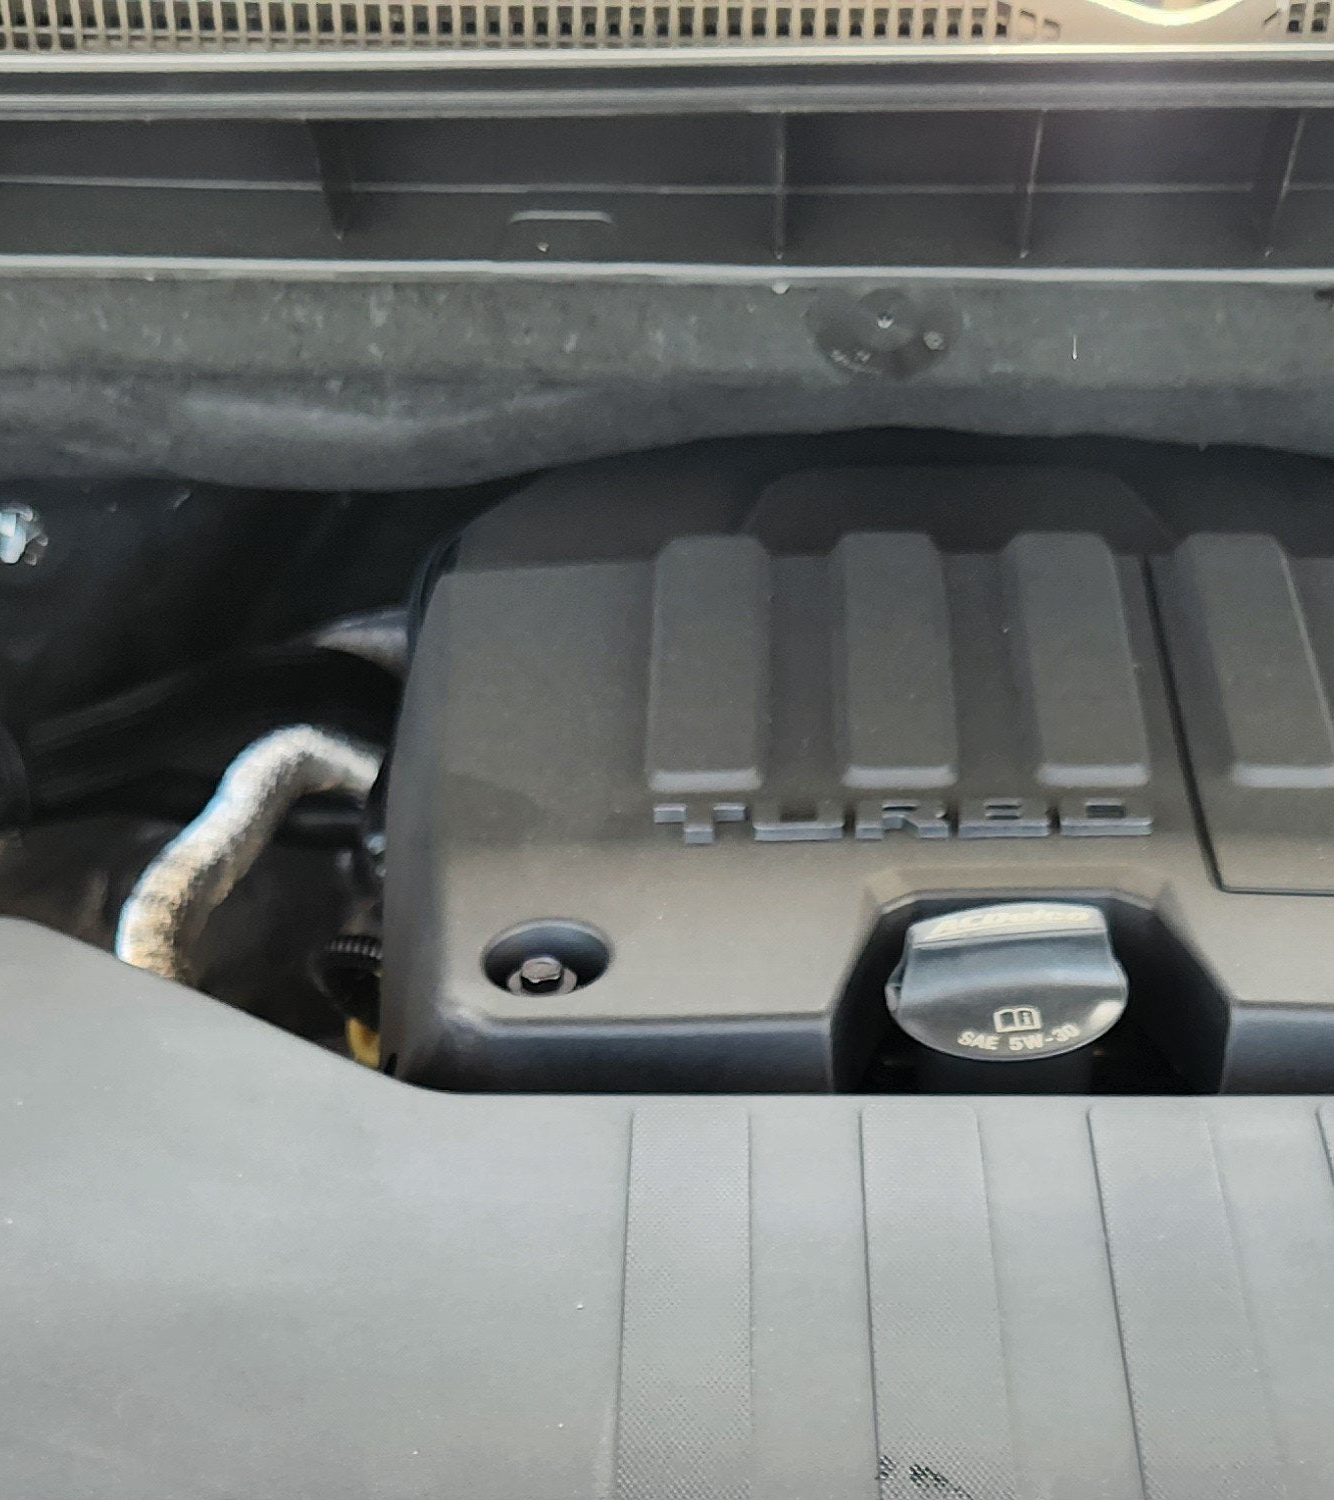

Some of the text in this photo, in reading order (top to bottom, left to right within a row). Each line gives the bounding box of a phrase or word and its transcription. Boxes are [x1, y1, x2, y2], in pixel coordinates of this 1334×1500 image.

[653, 794, 1154, 844] TURBO
[957, 1024, 1081, 1051] SAE 5W-30
